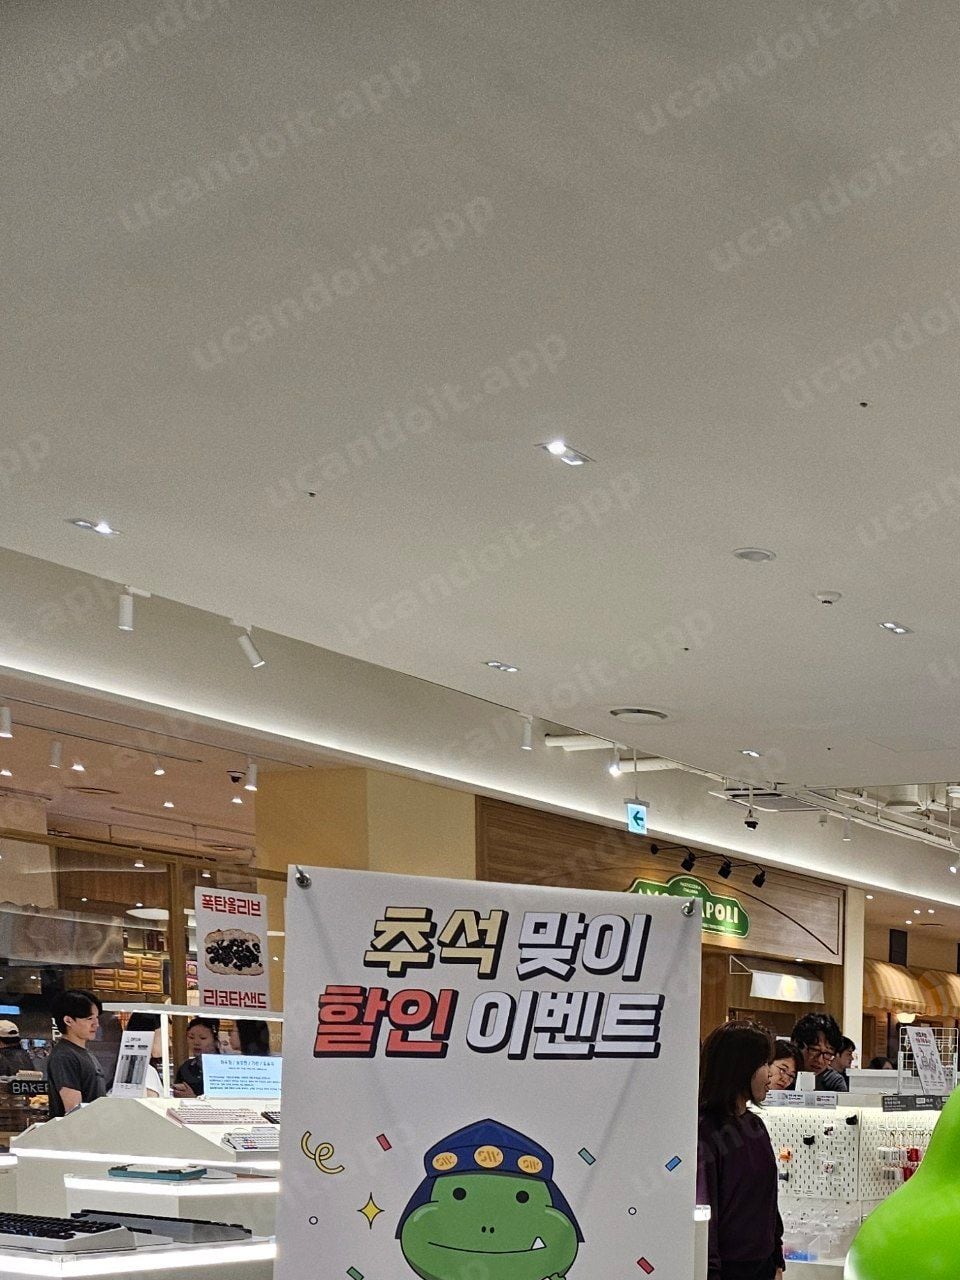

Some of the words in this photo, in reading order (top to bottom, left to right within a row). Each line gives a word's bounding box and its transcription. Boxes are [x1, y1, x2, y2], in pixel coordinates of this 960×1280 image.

[202, 893, 261, 917] 폭탄올리브
[702, 902, 739, 924] POLI
[364, 906, 509, 980] 추석
[516, 911, 652, 982] 맞이
[203, 988, 267, 1009] 리코타샌드
[313, 985, 459, 1058] 할인
[466, 989, 665, 1060] 이벤트
